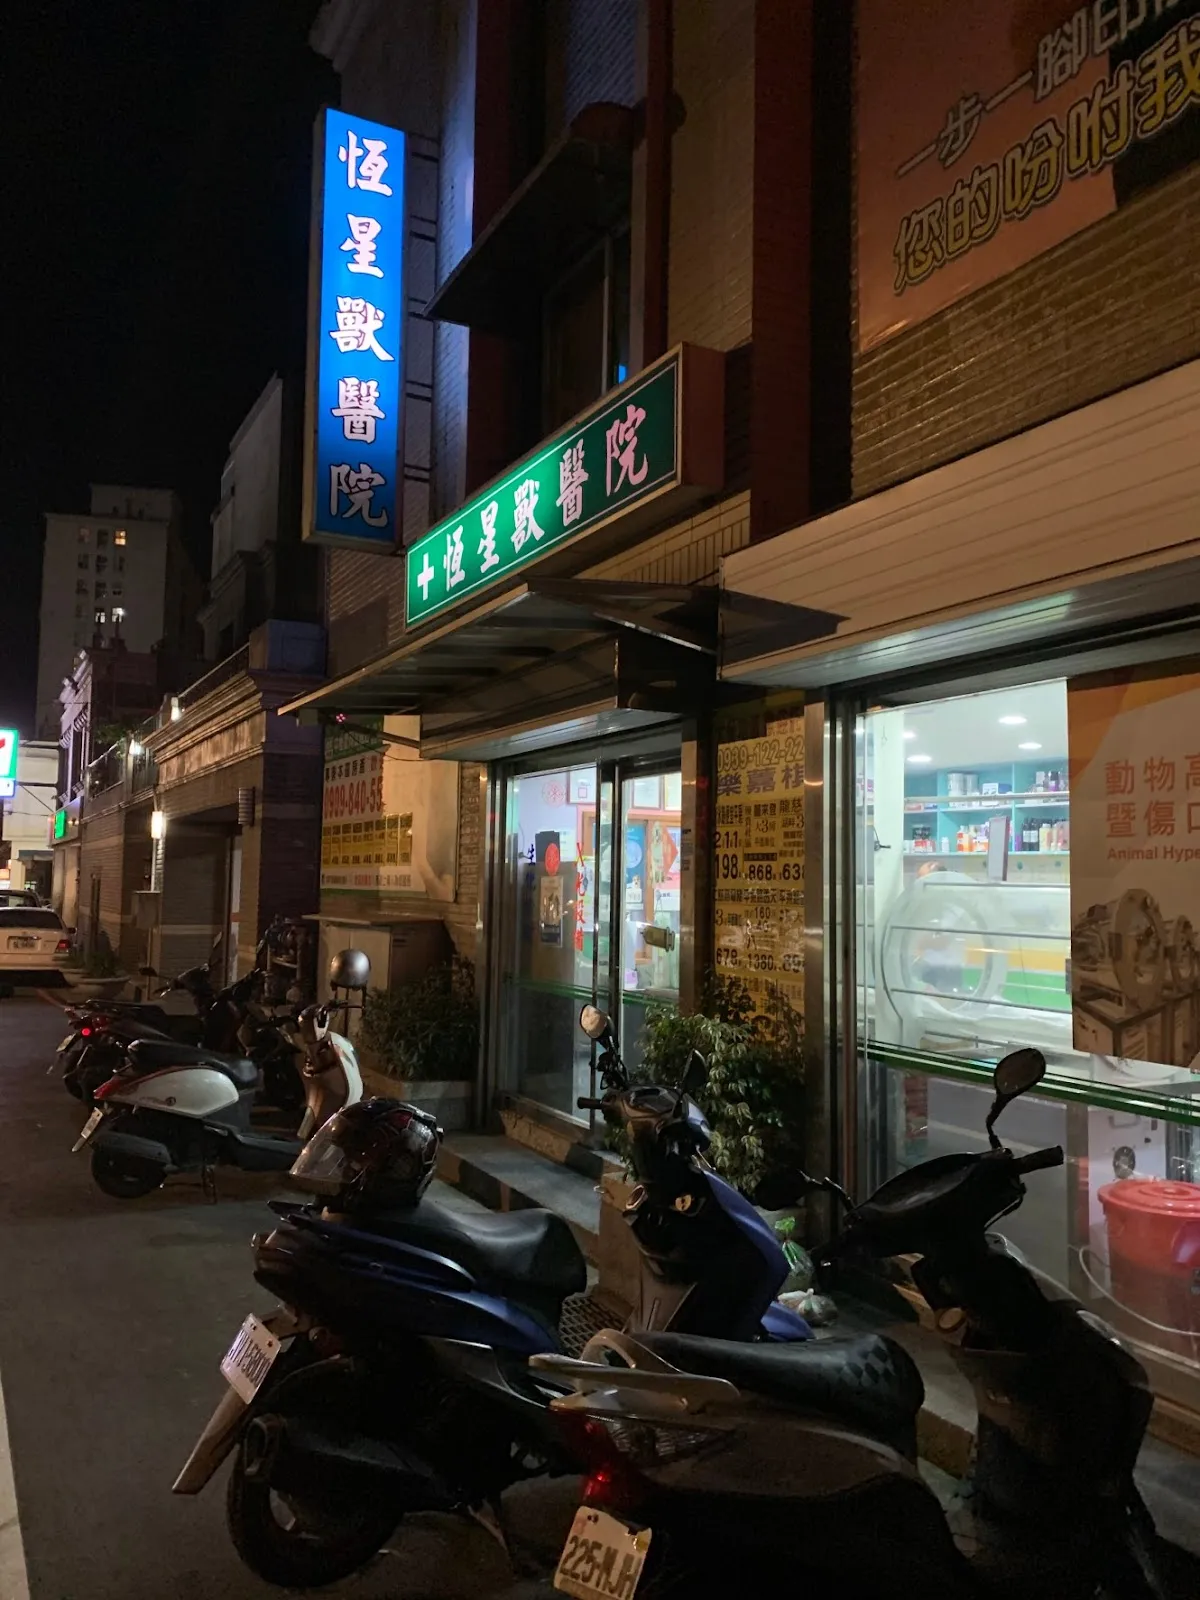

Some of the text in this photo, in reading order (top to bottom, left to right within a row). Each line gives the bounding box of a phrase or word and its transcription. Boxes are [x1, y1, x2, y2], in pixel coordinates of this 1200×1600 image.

[329, 129, 395, 528] 恆星獸醫院
[442, 403, 650, 592] 恆星獸醫院
[1107, 845, 1158, 860] Animal
